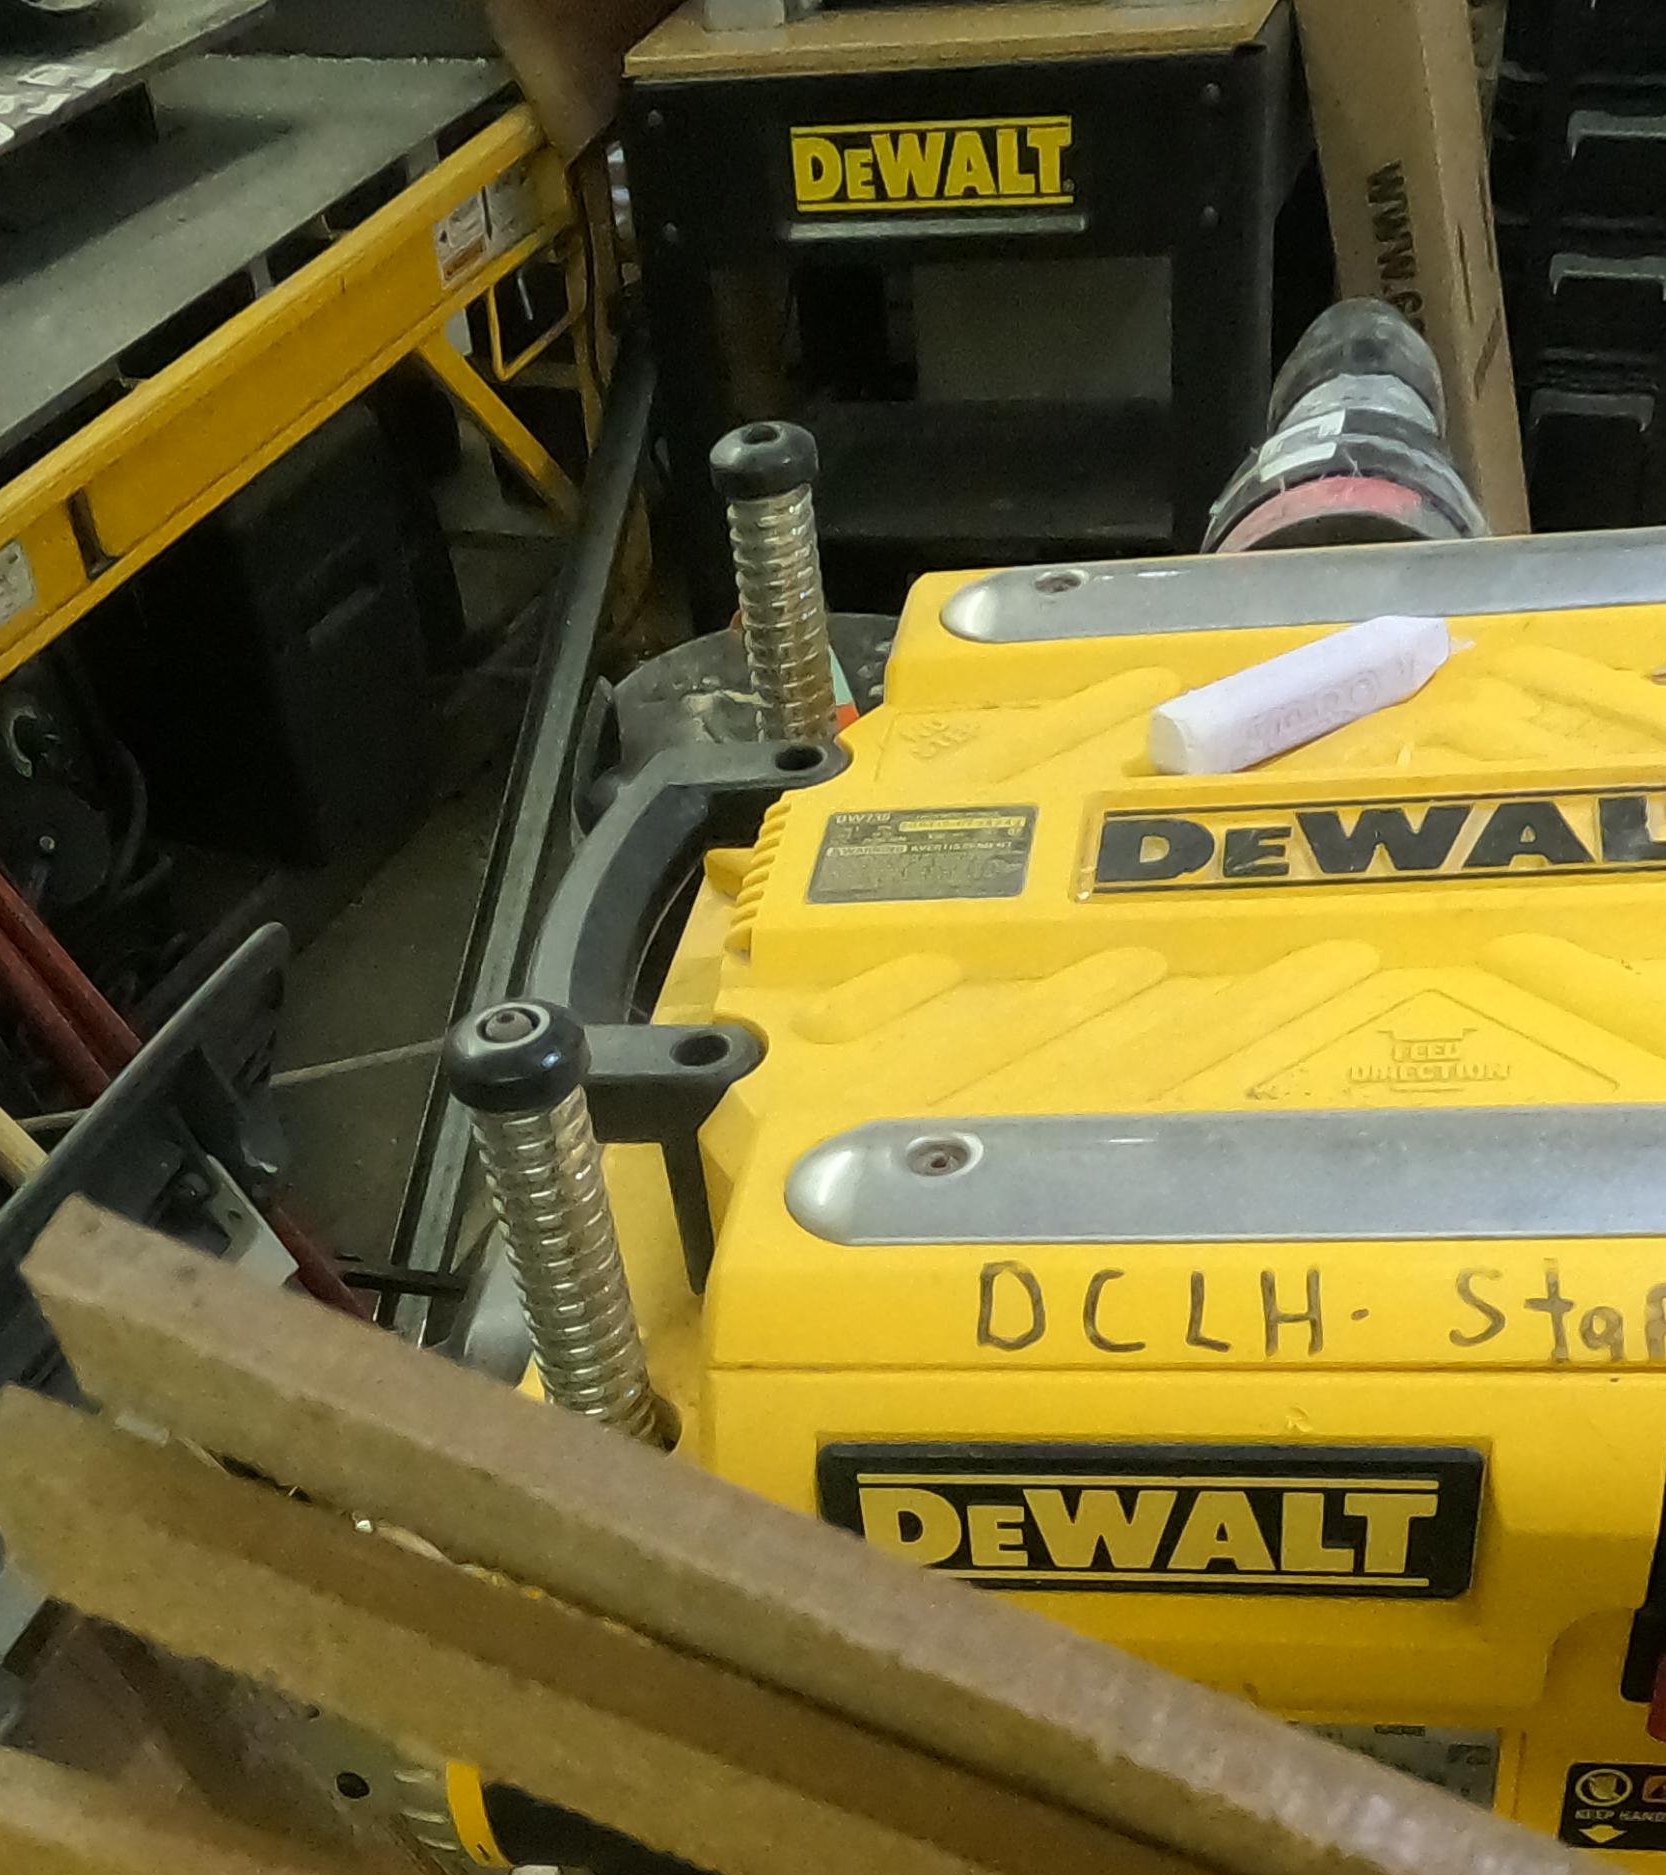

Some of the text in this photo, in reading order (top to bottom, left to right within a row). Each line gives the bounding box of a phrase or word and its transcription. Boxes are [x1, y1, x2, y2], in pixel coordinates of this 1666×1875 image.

[1393, 1041, 1461, 1060] FEED
[1351, 1062, 1510, 1082] DIRECTION
[1574, 1809, 1616, 1821] KEEP
